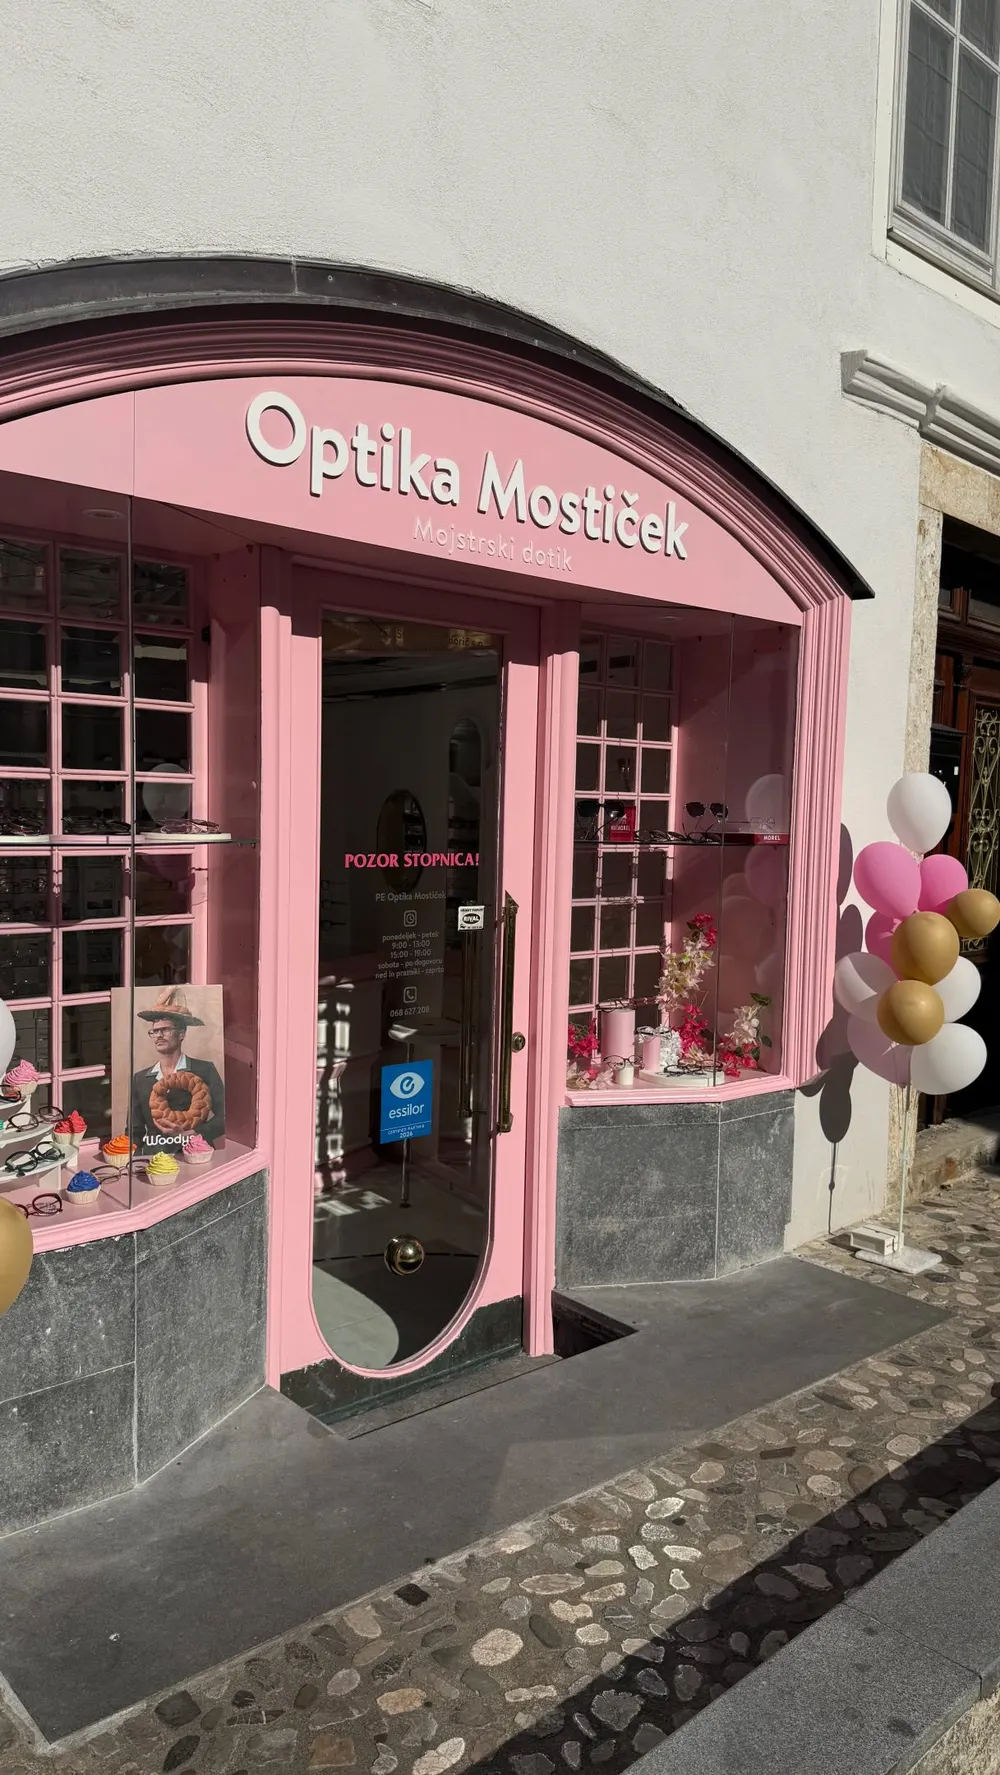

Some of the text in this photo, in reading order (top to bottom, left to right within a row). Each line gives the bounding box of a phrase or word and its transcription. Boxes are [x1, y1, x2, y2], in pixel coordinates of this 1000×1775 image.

[245, 391, 689, 560] Optika Mostiček
[413, 516, 573, 571] Mojstrski dotik
[344, 852, 479, 868] POZOR STOPNICA!
[375, 892, 386, 902] PE
[387, 892, 412, 903] Optika
[382, 931, 416, 944] ponedeljek
[421, 930, 439, 939] petek
[391, 941, 408, 949] 9:00
[413, 939, 430, 948] 13:00
[390, 950, 408, 959] 15:00
[414, 948, 431, 957] 19:00
[378, 961, 400, 969] sobota
[405, 960, 413, 968] po
[375, 971, 388, 979] ned
[390, 1009, 403, 1018] 068
[403, 1007, 417, 1016] 627
[388, 1103, 425, 1119] essilor
